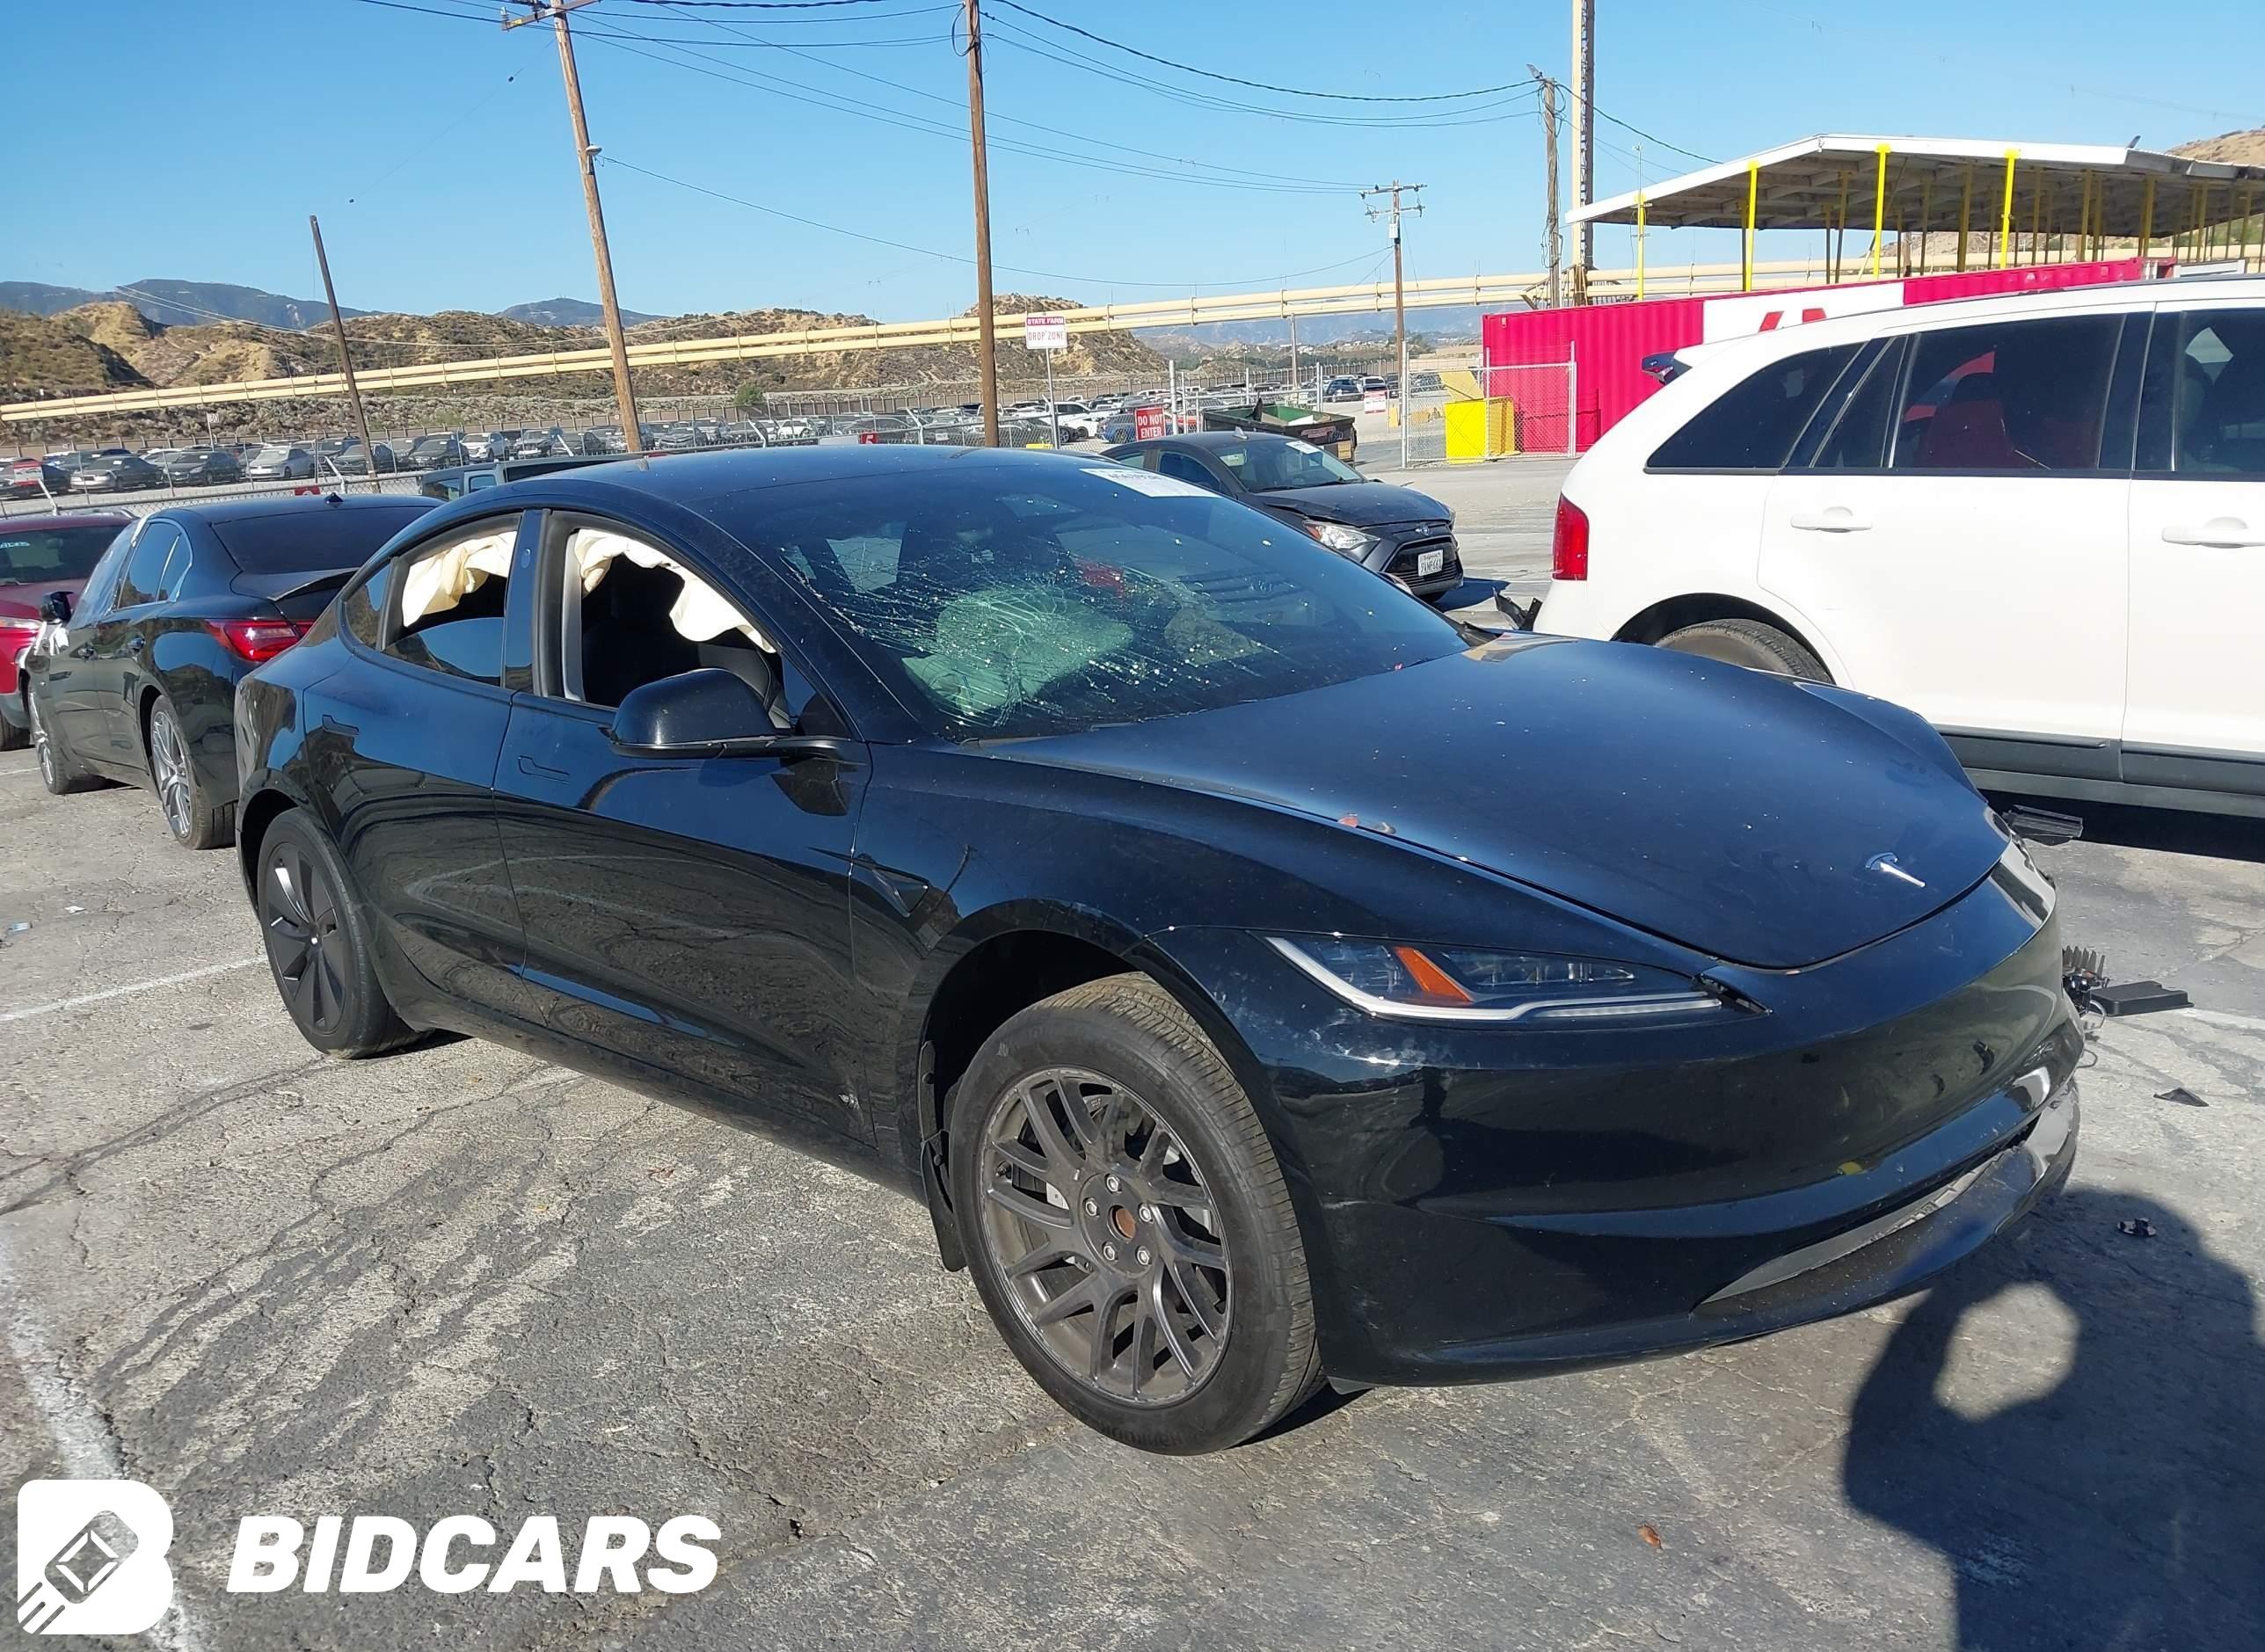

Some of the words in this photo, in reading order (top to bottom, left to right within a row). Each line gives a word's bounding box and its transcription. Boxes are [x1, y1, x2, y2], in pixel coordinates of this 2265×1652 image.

[1028, 331, 1045, 341] DROP
[1047, 331, 1065, 340] ZONE
[1137, 415, 1147, 426] DO
[1149, 414, 1162, 426] NOT
[1140, 426, 1162, 439] ENTER
